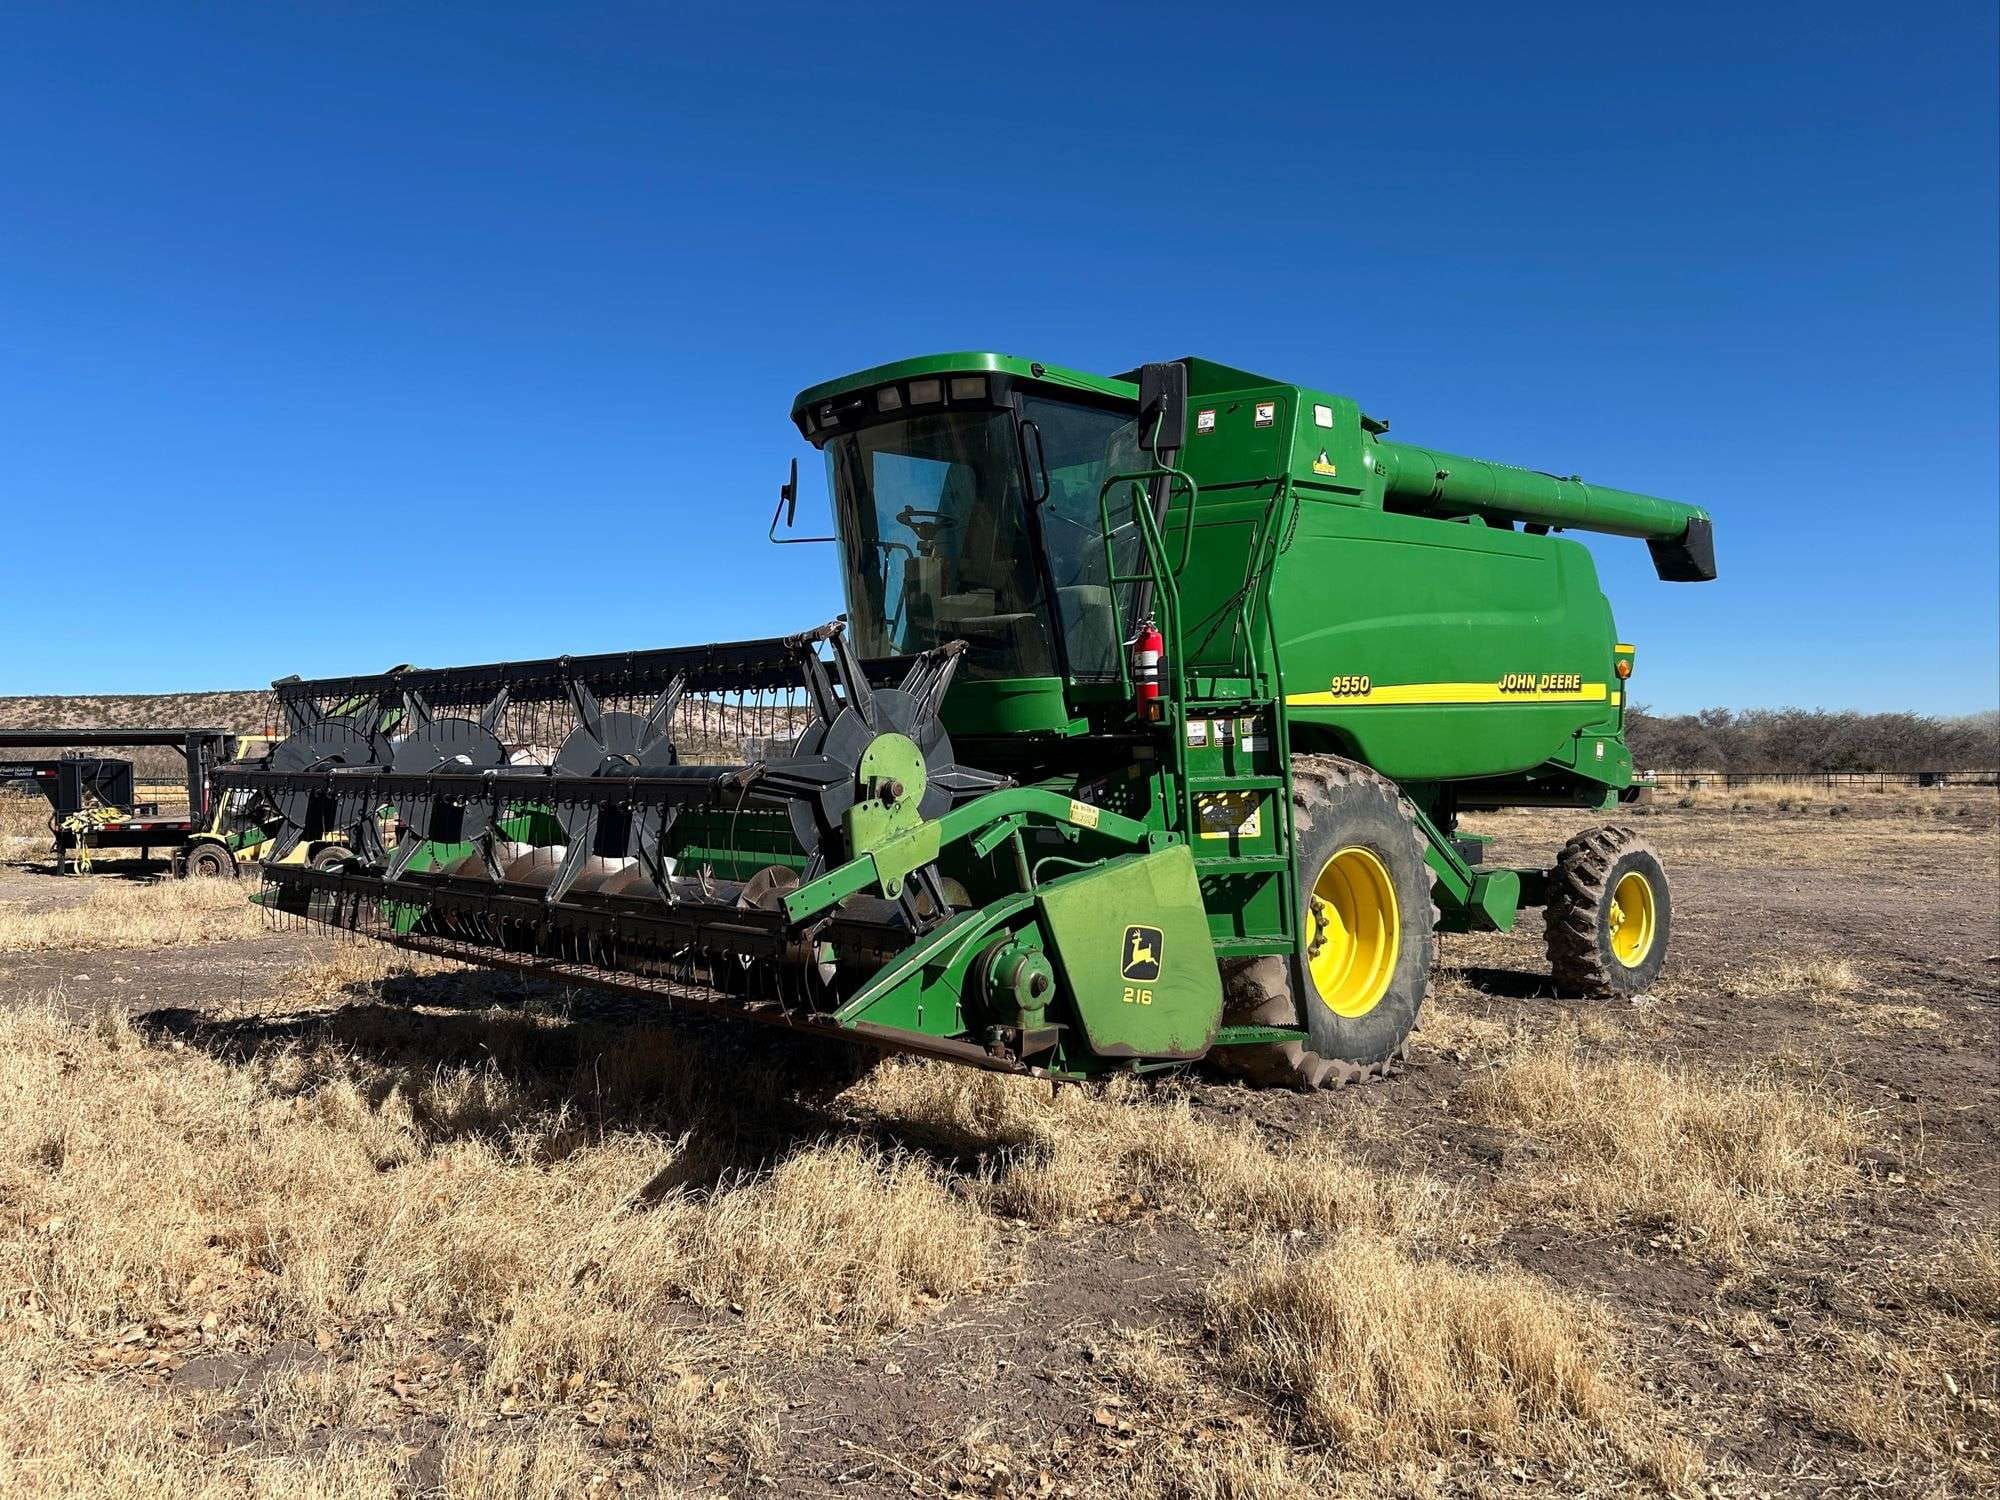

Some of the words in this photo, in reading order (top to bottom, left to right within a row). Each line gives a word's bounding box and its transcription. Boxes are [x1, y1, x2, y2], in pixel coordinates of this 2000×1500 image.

[1331, 675, 1370, 695] 9550
[1498, 673, 1537, 692] JOHN
[1541, 673, 1581, 692] DEERE
[1122, 986, 1153, 1005] 216
